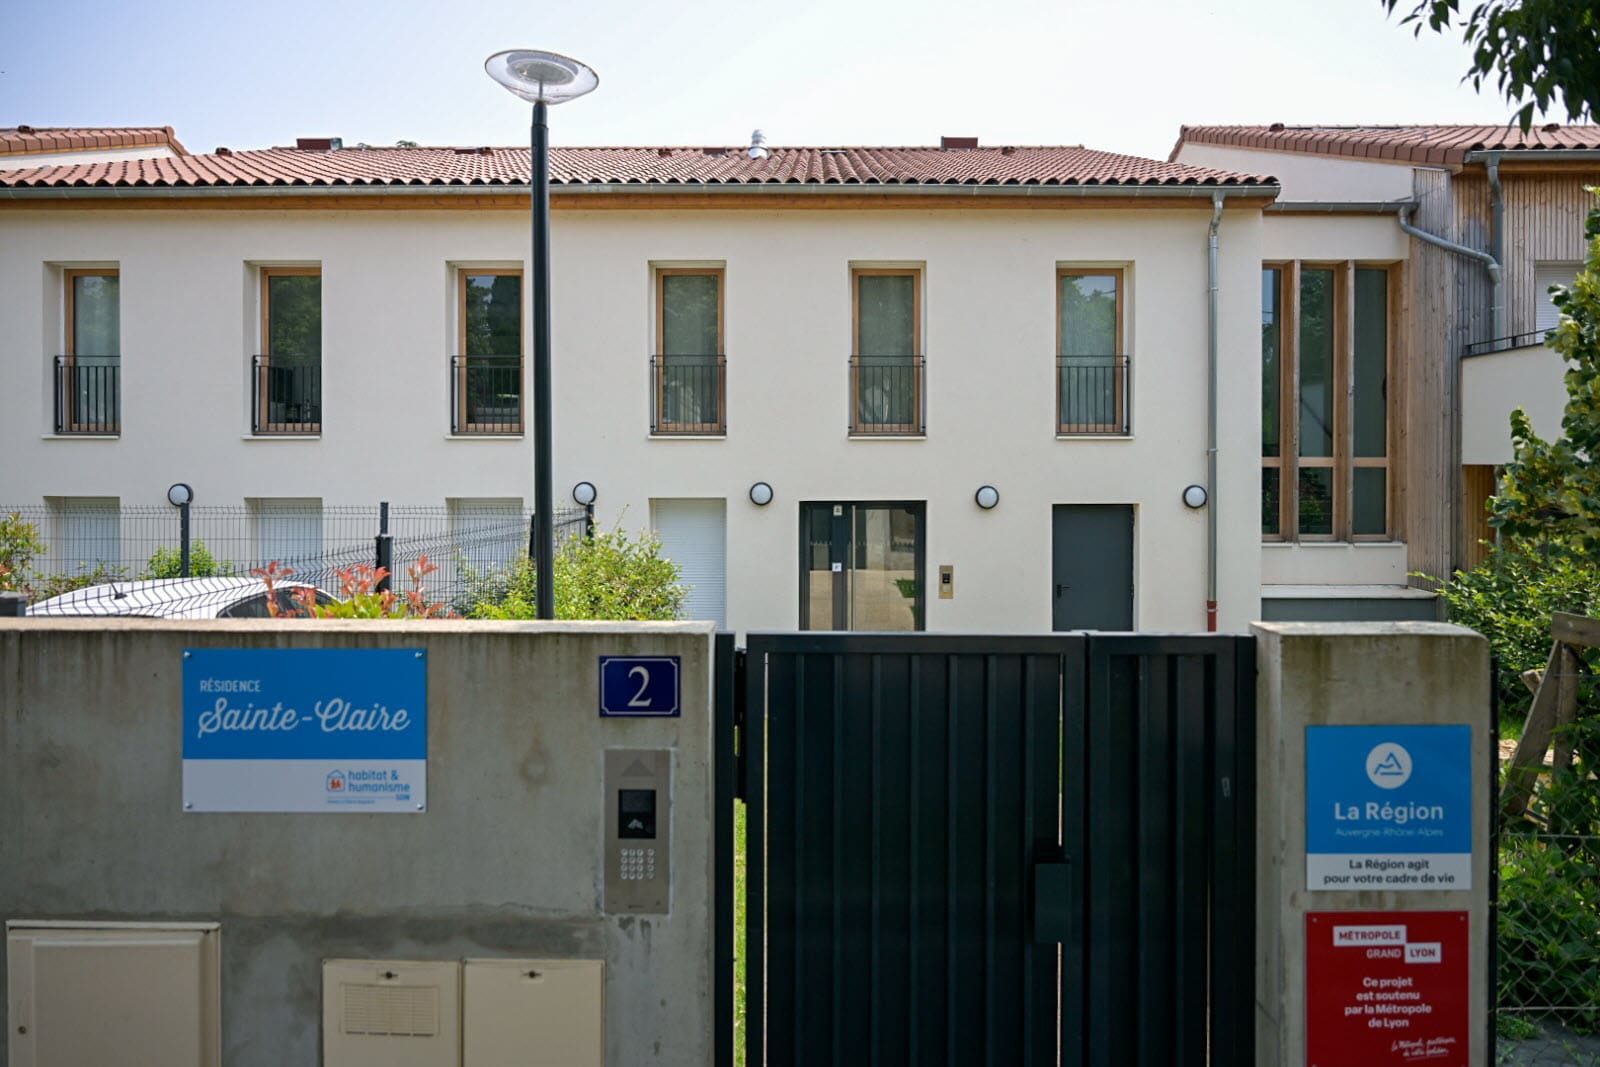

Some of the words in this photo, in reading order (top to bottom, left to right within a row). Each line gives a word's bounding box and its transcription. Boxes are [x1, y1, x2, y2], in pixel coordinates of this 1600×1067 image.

[200, 678, 261, 693] RÉSIDENCE
[627, 665, 652, 707] 2
[348, 769, 387, 781] habitat
[391, 769, 399, 781] &
[348, 782, 410, 792] humanisme
[1334, 802, 1359, 820] La
[1366, 801, 1444, 824] Région
[1349, 859, 1362, 869] La
[1365, 859, 1405, 871] Région
[1407, 859, 1429, 871] agit
[1324, 874, 1351, 885] pour
[1353, 873, 1383, 883] votre
[1385, 873, 1418, 883] cadre
[1421, 873, 1435, 883] de
[1437, 873, 1455, 883] vie
[1339, 930, 1401, 941] MÉTROPOLE
[1366, 948, 1402, 959] GRAND
[1410, 948, 1436, 958] LYON
[1362, 976, 1378, 987] Ce
[1379, 976, 1414, 989] projet
[1356, 991, 1375, 1001] est
[1376, 990, 1420, 1001] soutenu
[1344, 1006, 1363, 1016] par
[1364, 1004, 1375, 1014] la
[1376, 1003, 1432, 1016] Métropole
[1368, 1018, 1382, 1028] de
[1384, 1017, 1410, 1029] Lyon
